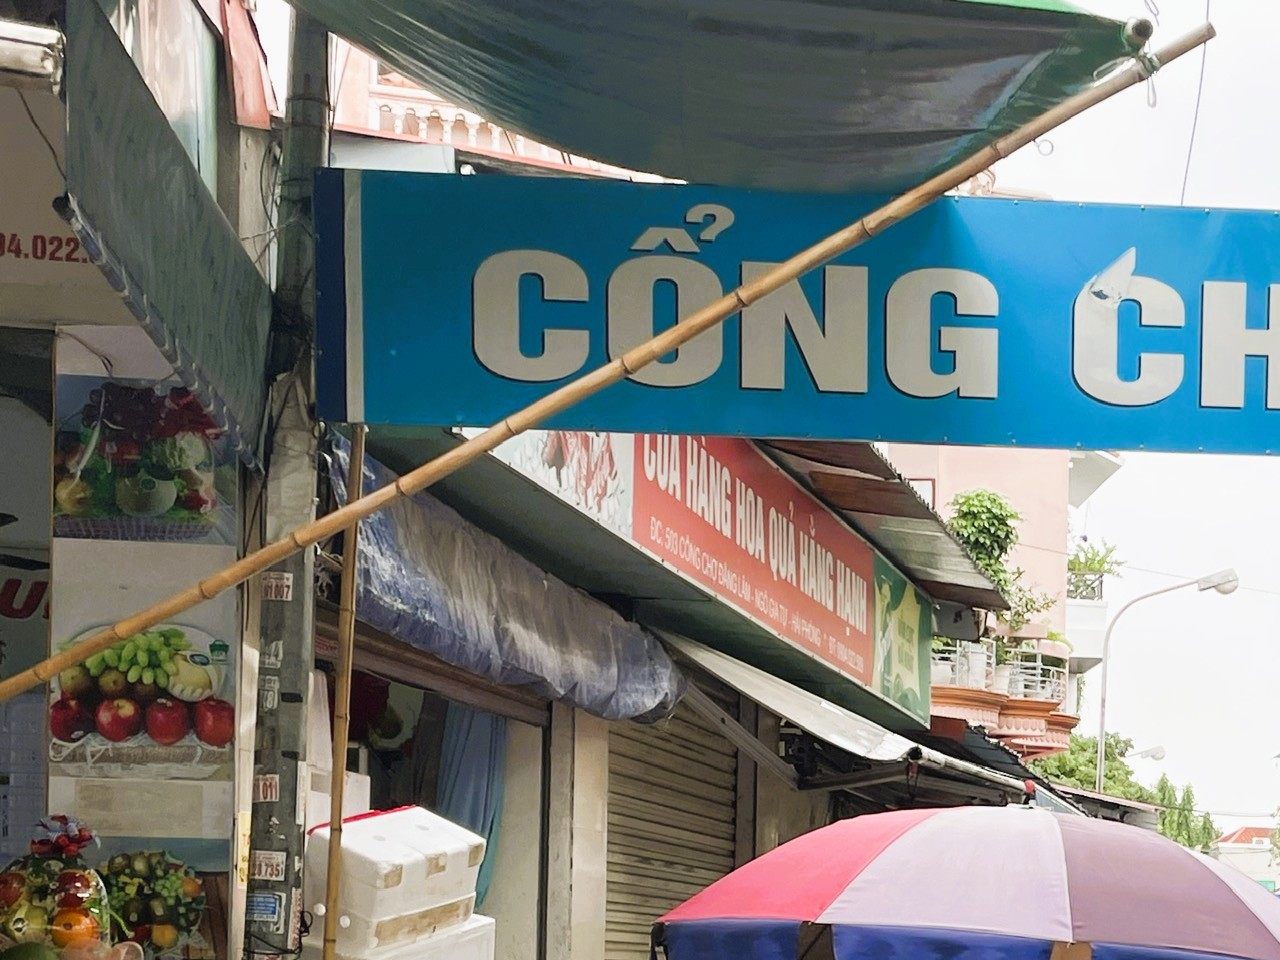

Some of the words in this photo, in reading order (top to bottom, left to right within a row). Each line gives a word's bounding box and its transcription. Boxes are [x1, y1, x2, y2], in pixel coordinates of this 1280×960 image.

[473, 204, 998, 398] CỔNG
[686, 434, 731, 540] HÀNG
[735, 477, 765, 565] HOA
[769, 501, 797, 589] QUẢ
[837, 559, 867, 636] HẠNH
